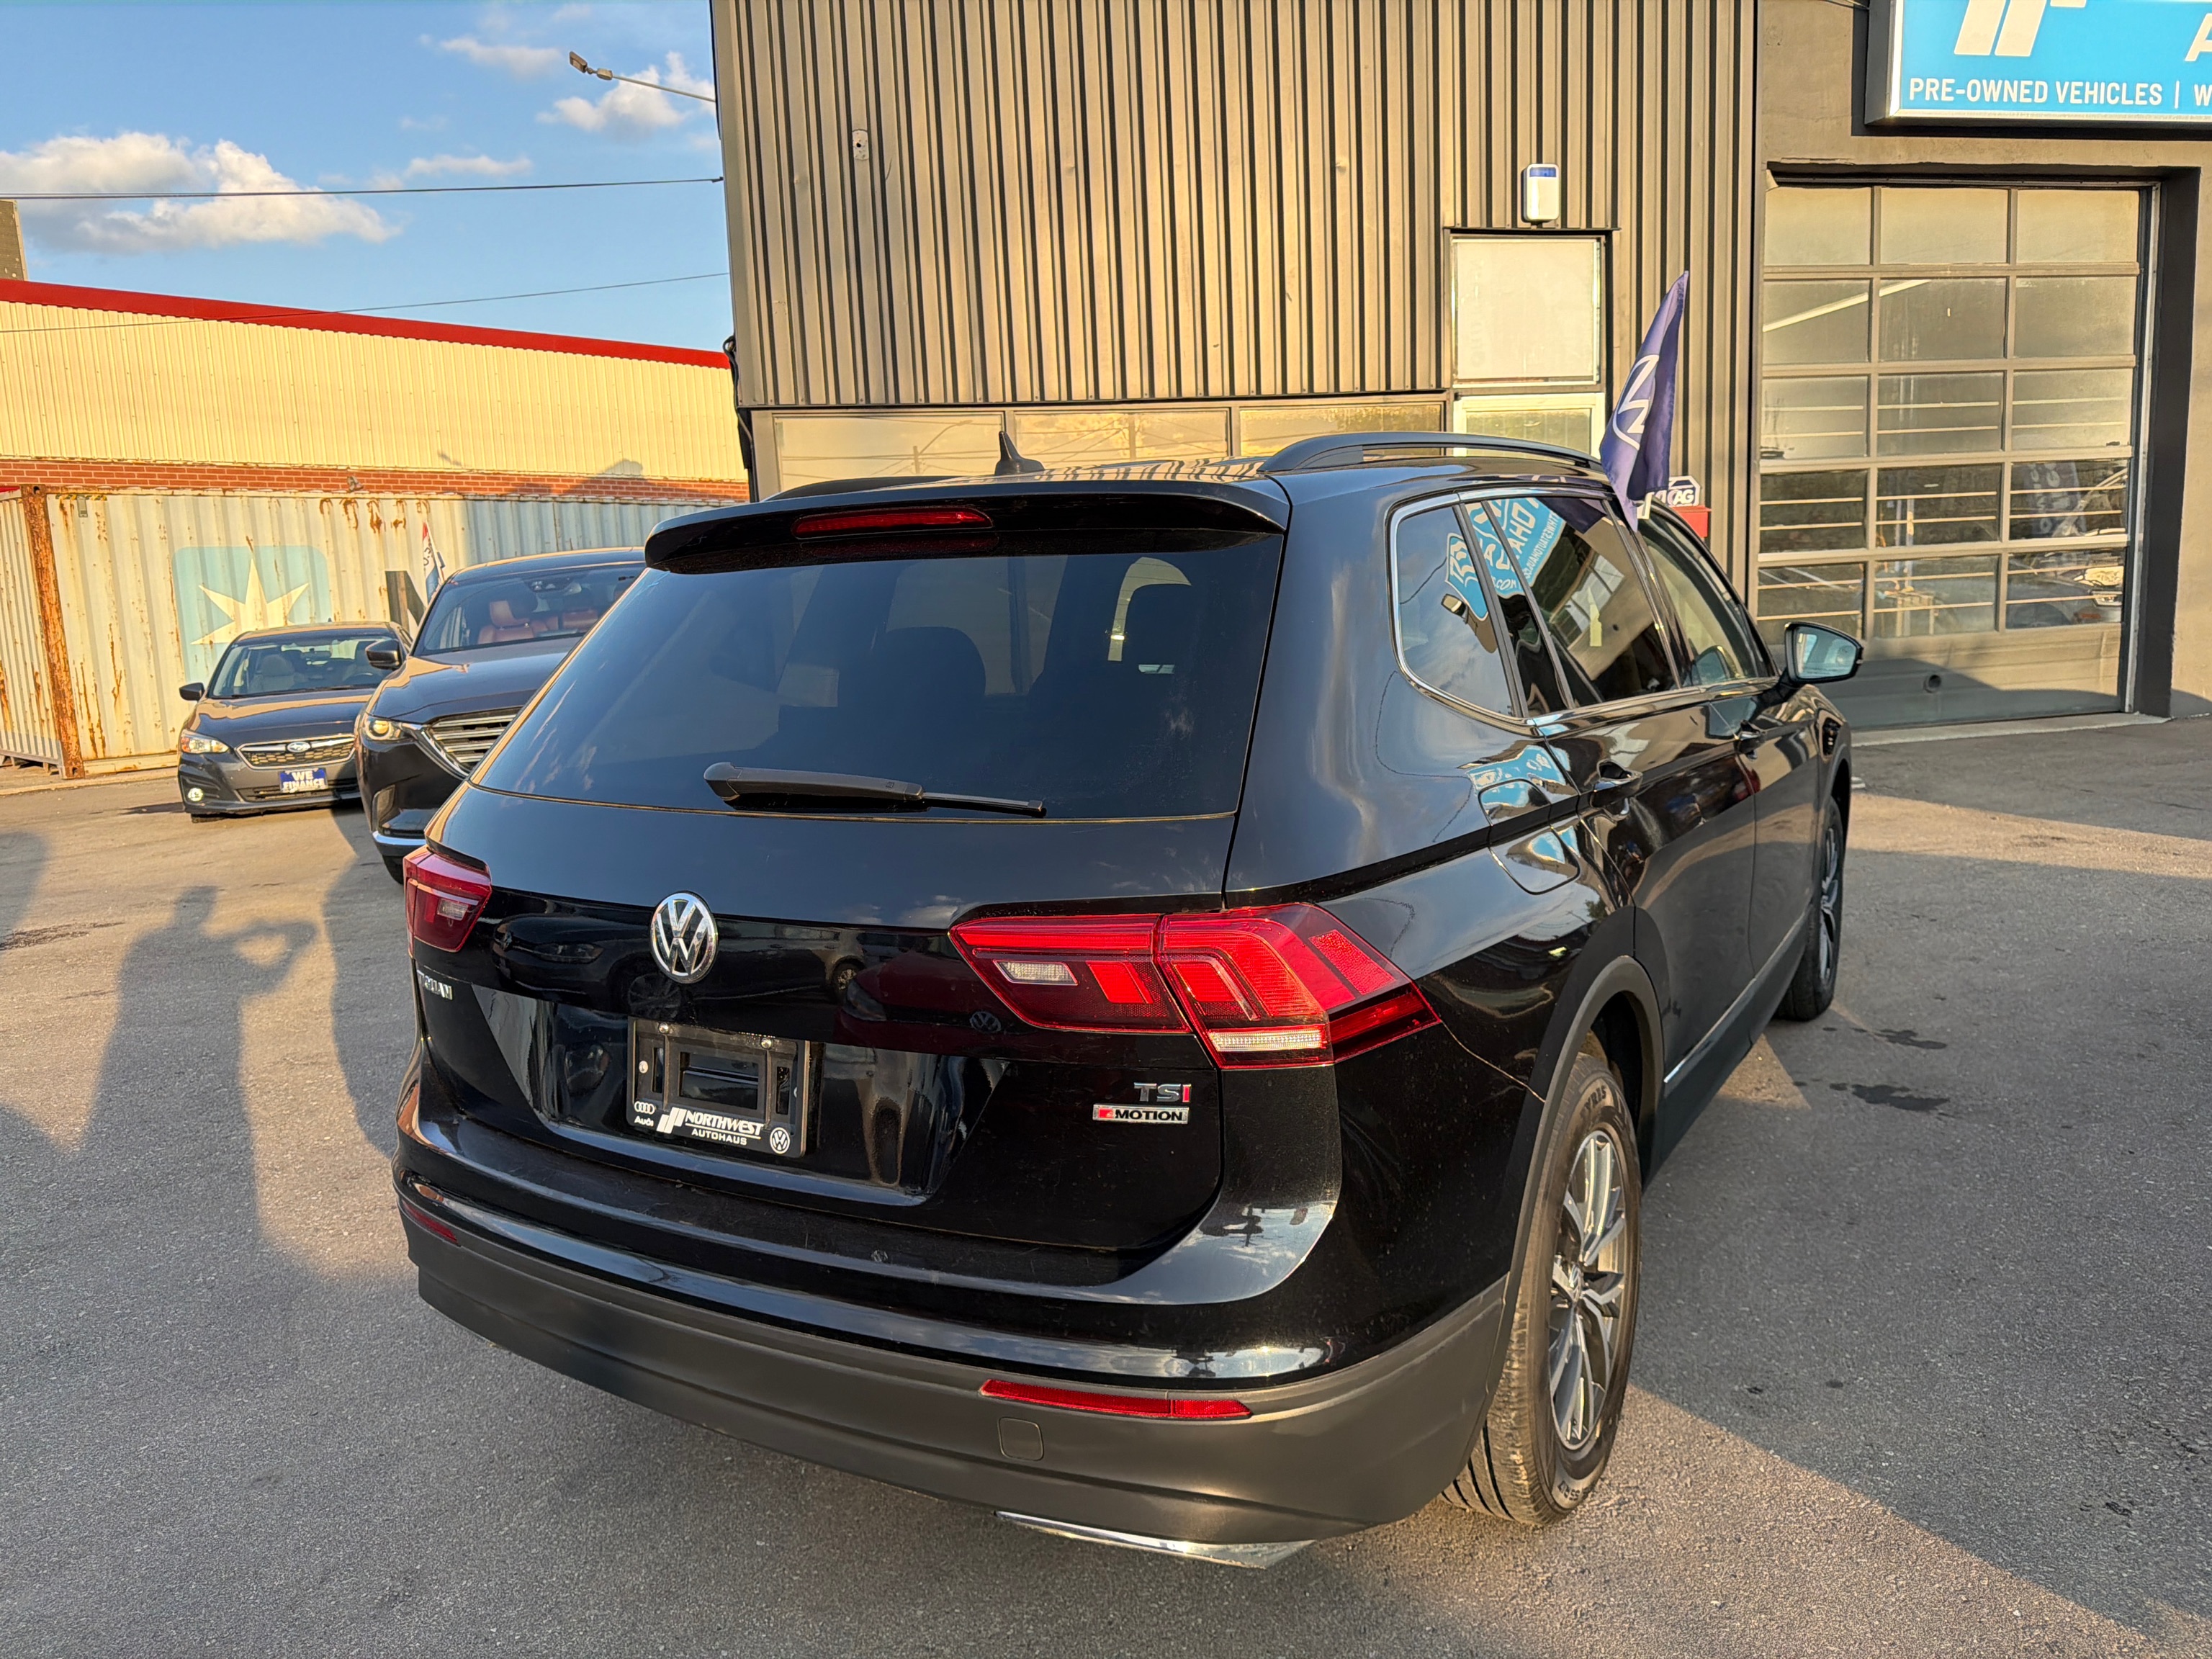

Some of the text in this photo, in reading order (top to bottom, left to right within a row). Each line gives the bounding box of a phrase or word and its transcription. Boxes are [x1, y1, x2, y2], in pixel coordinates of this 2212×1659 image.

[1909, 77, 2049, 104] PRE-OWNED
[2055, 81, 2163, 106] VEHICLES
[292, 770, 313, 781] WE
[1133, 1082, 1192, 1103] TSI
[634, 1115, 655, 1128] Audi
[685, 1110, 765, 1136] NORTHWEST
[691, 1128, 747, 1146] AUTOHAUS
